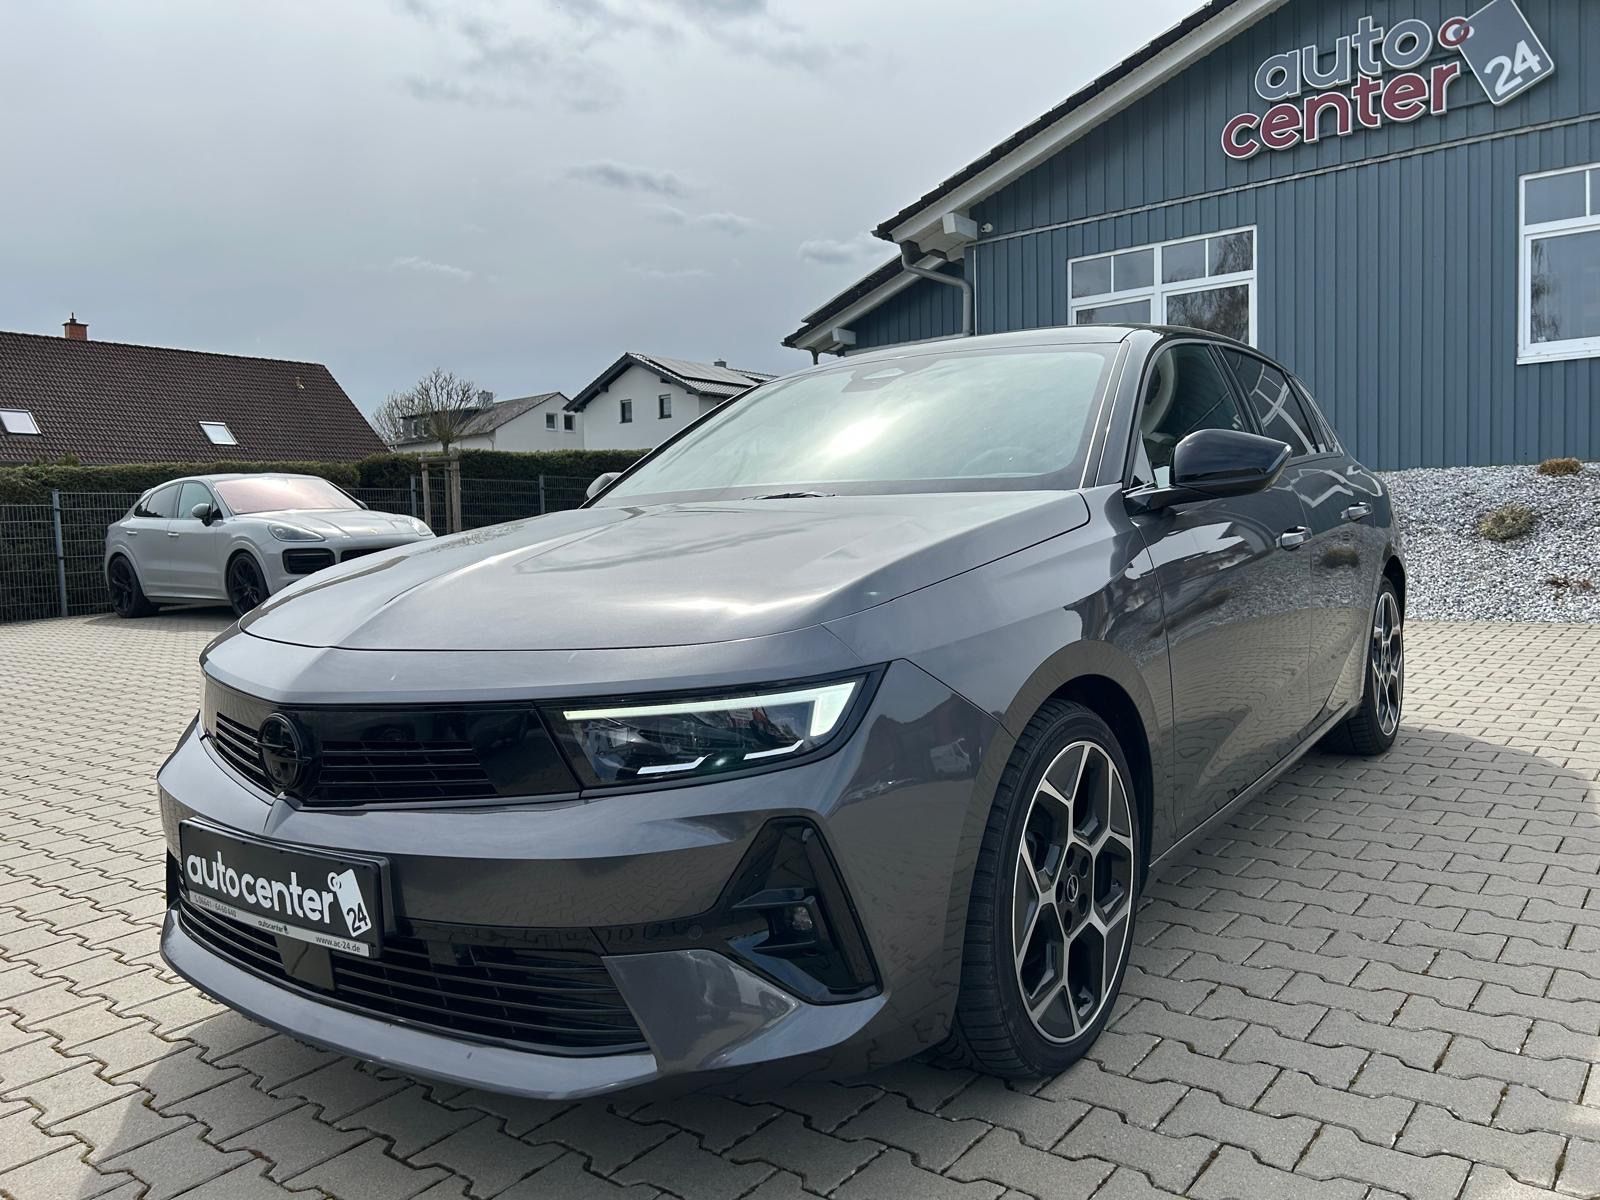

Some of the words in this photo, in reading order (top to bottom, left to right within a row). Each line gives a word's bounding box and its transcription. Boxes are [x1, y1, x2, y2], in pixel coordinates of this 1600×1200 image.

[1255, 15, 1433, 100] auto
[1483, 39, 1542, 96] 24
[1221, 61, 1461, 160] center
[186, 851, 334, 924] autocenter
[346, 902, 368, 934] 24
[315, 936, 361, 953] www.ac-24.de
